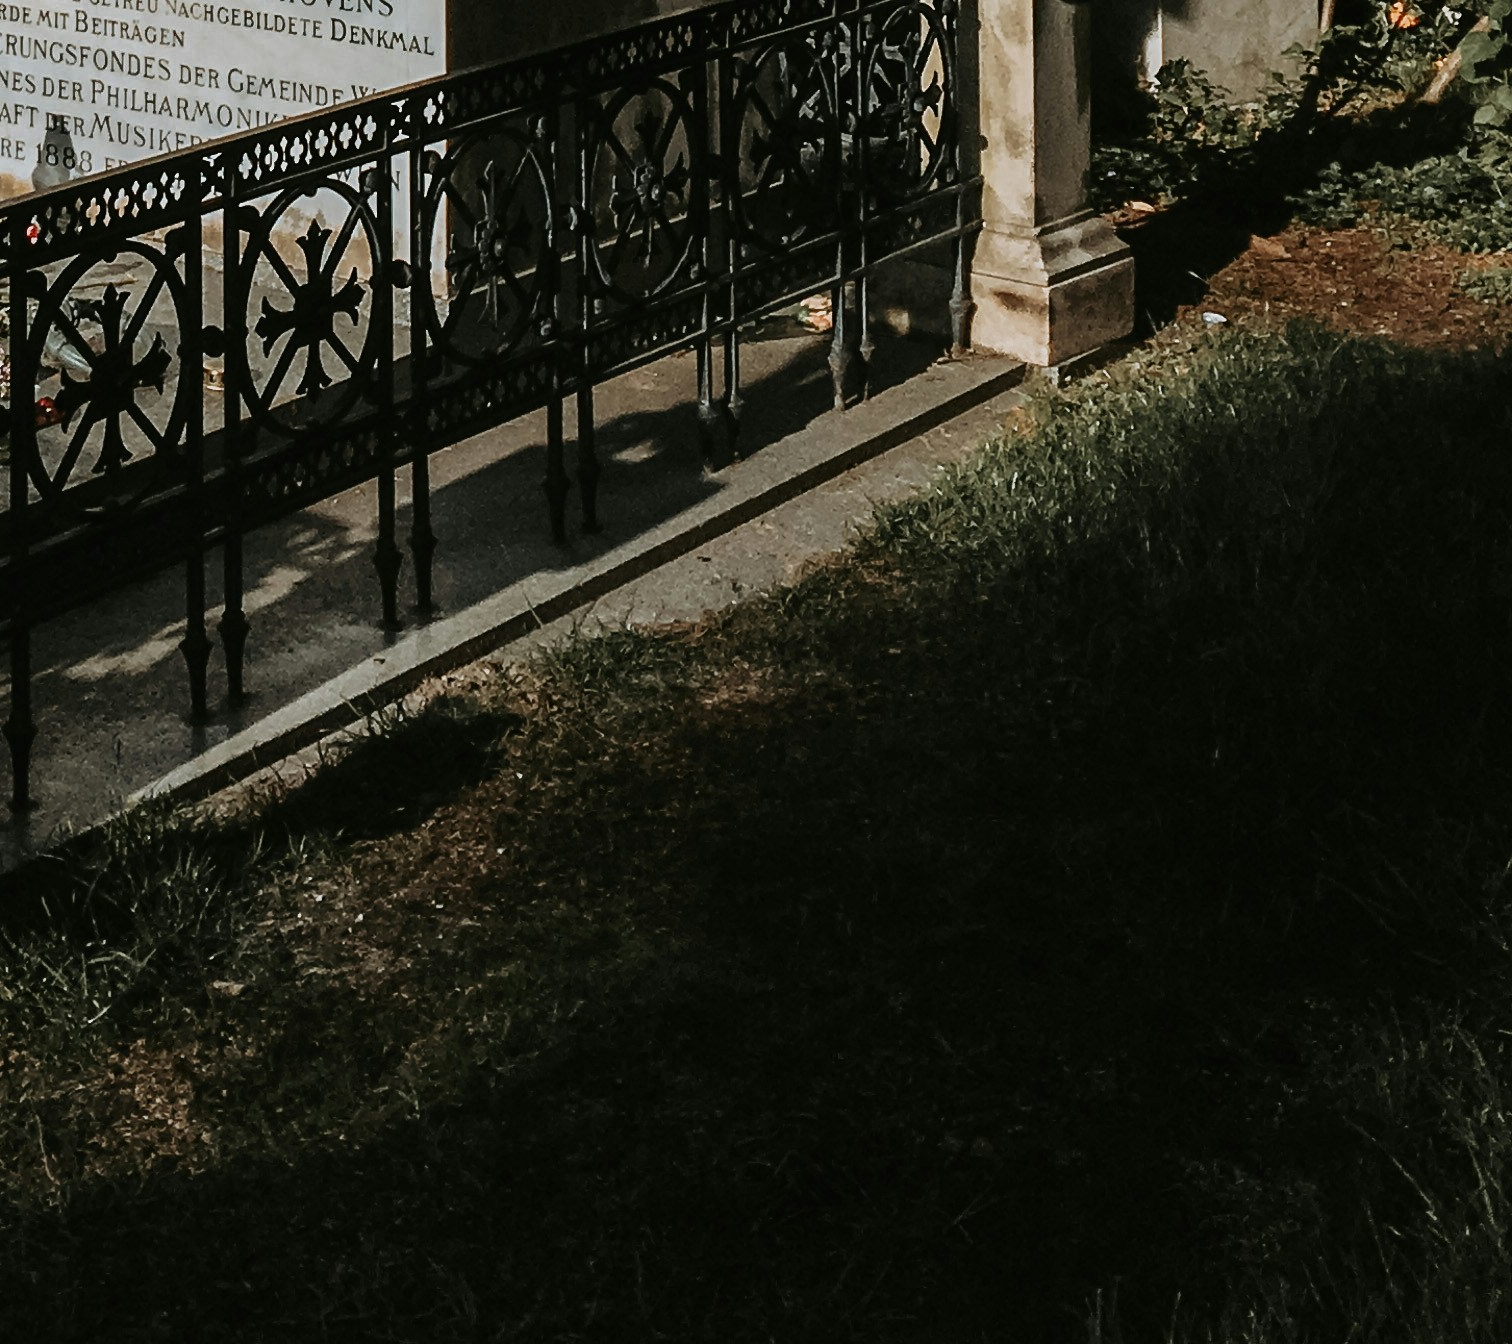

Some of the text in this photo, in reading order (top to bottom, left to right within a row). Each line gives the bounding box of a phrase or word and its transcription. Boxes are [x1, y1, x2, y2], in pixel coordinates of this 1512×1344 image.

[36, 10, 69, 30] MIT
[75, 9, 186, 47] BEITRÄGEN
[330, 17, 434, 56] DENKMAL
[179, 64, 219, 89] DER
[43, 77, 84, 102] DER
[91, 79, 287, 129] PHILHARMONIK
[45, 112, 85, 137] DER
[36, 143, 92, 173] 1888
